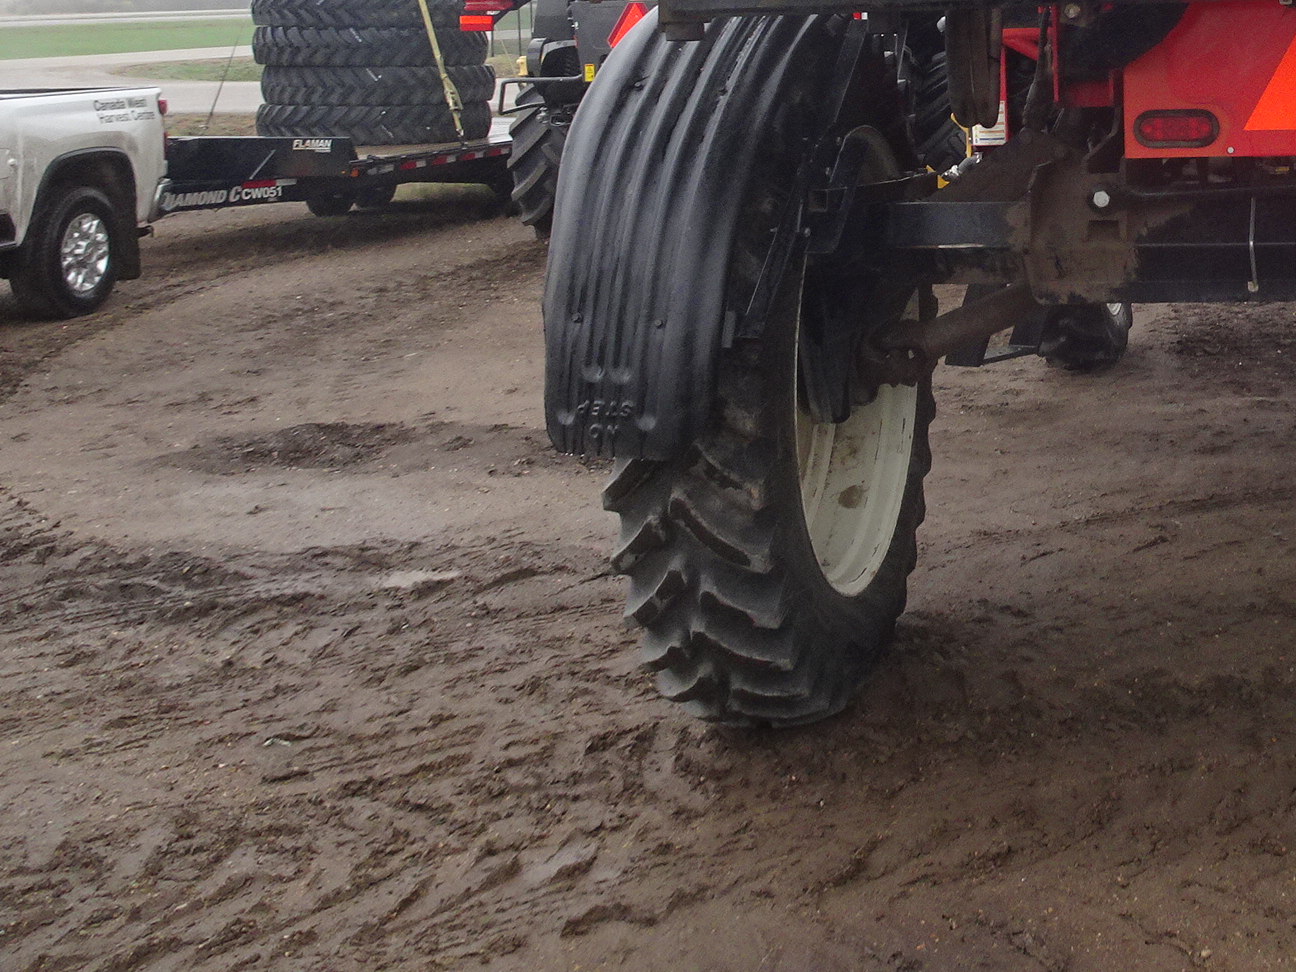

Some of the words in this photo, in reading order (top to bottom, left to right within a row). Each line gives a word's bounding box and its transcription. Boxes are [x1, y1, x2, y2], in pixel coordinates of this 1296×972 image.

[94, 98, 126, 111] Canada
[98, 112, 132, 124] Harvest
[292, 139, 332, 148] FLAMAN
[241, 186, 283, 200] CW051
